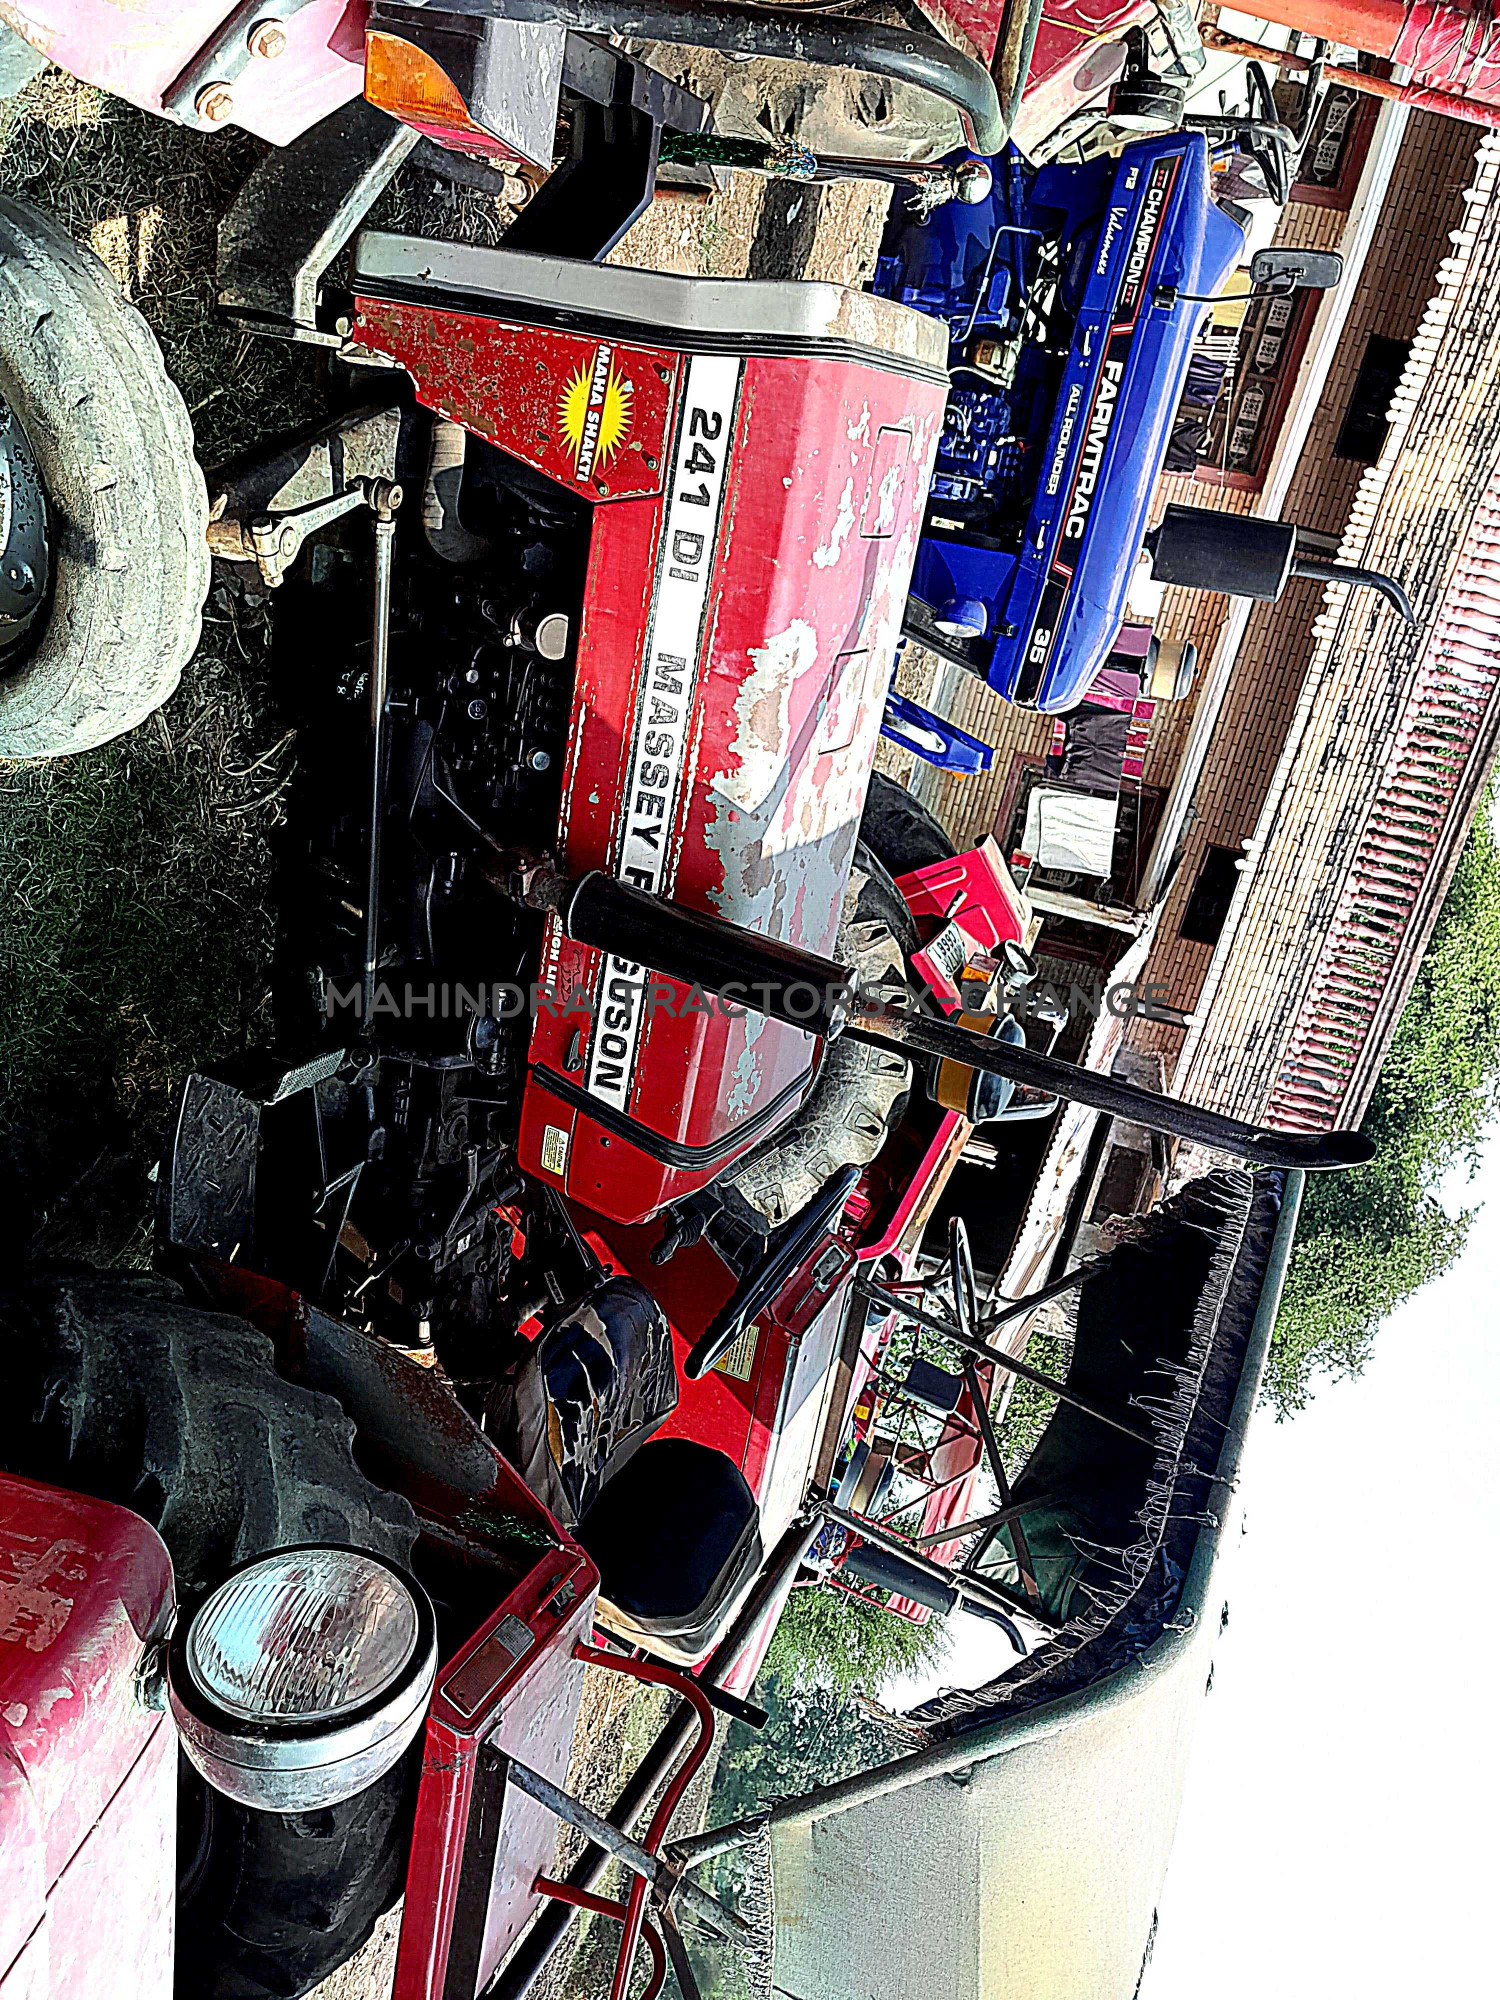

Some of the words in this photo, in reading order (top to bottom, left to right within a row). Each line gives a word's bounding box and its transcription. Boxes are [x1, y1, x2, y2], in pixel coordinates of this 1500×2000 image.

[1126, 188, 1162, 284] CHAMPION
[586, 344, 612, 405] MAHA
[1064, 385, 1081, 416] ALL
[575, 406, 600, 483] SHAKTI
[680, 407, 723, 514] 241
[1046, 418, 1074, 496] ROUNDER
[1064, 360, 1124, 538] FARMTRAC
[668, 528, 705, 583] DI
[1029, 628, 1050, 664] 35
[630, 651, 687, 854] MASSEY
[595, 866, 654, 1092] FGUSON
